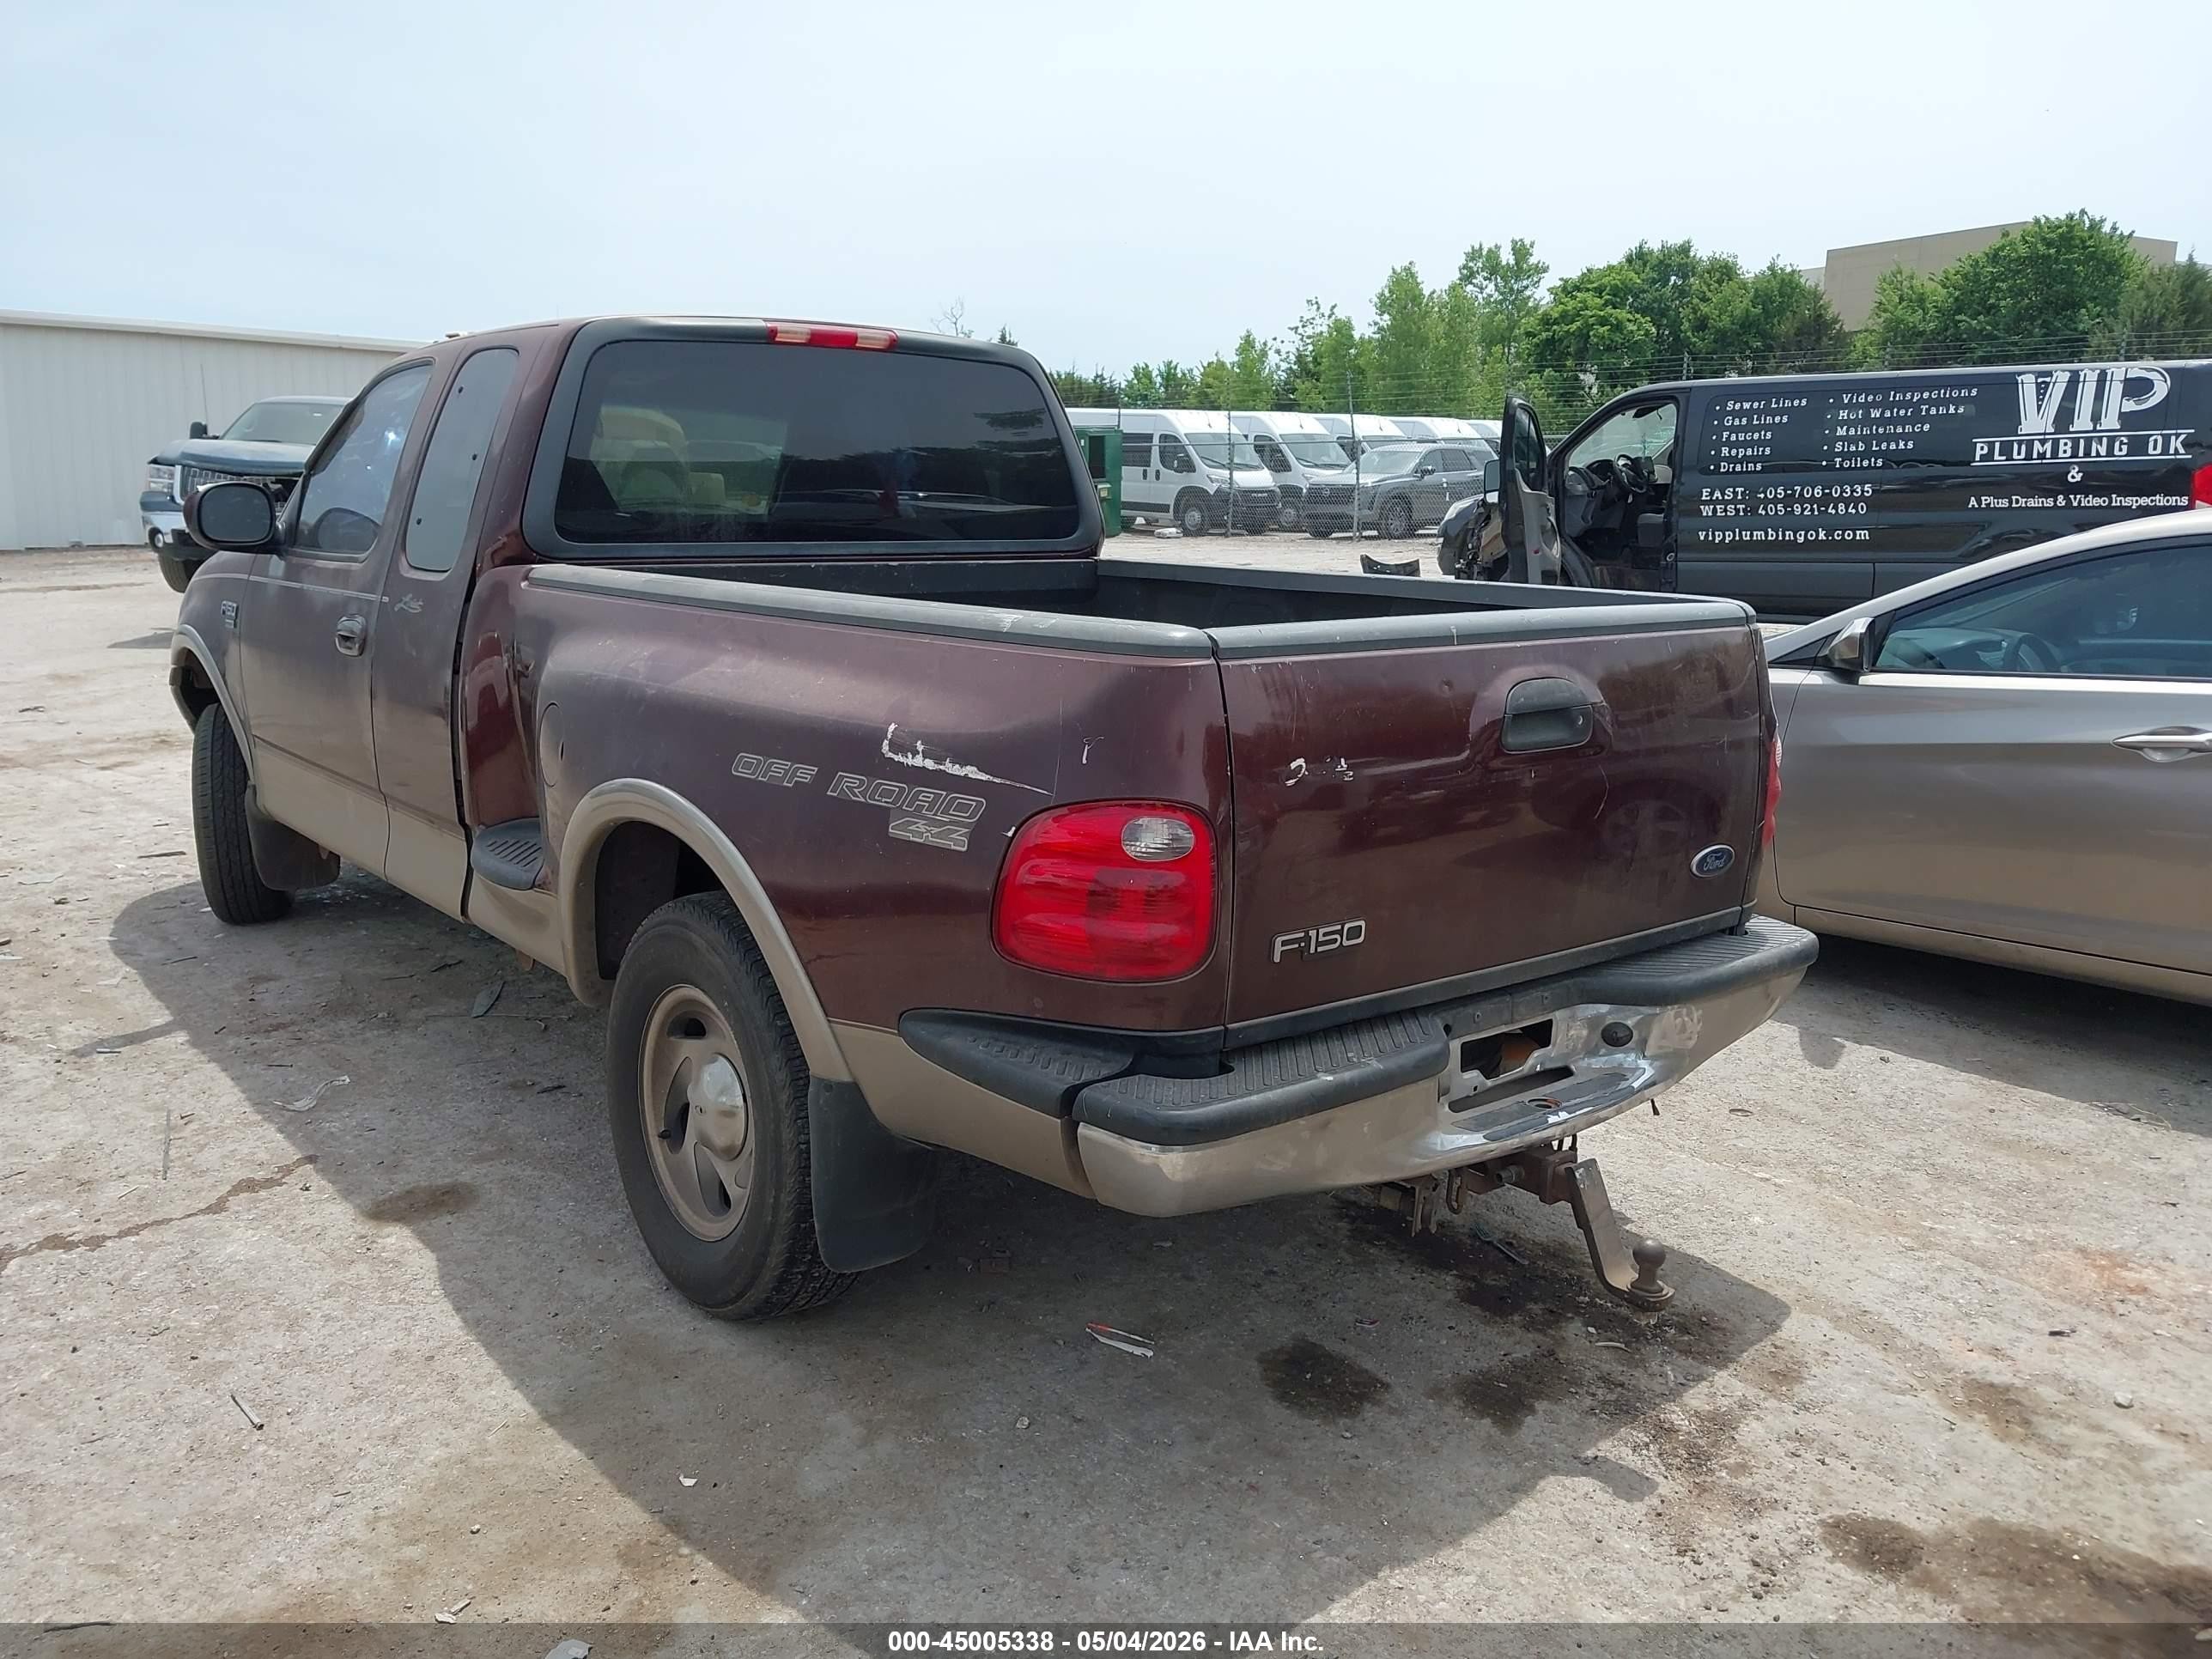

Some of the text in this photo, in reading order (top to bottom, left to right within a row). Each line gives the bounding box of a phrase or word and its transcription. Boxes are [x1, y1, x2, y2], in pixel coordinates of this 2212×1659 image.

[1842, 386, 1978, 404] Video Inspections
[2016, 366, 2172, 434] VIP
[1726, 398, 1808, 410] Sewer Lines
[1838, 404, 1966, 420] Hot Water Tanks
[1723, 414, 1789, 426] Gas Lines
[1721, 430, 1772, 441] Faucets
[1836, 422, 1930, 436] Maintenance
[1720, 446, 1771, 459] Repairs
[1834, 439, 1914, 453] Slab Leaks
[1975, 434, 2189, 462] PLUMBING OK
[1719, 461, 1763, 472] Drains
[1834, 457, 1883, 468] Toilets
[2067, 465, 2084, 483] &
[1701, 483, 1873, 501] EAST: 405-706-0335
[1967, 493, 2189, 508] A Plus Drains & Video Inspections
[1699, 502, 1868, 516] WEST: 405-921-4840
[1698, 527, 1870, 544] vipplumbingok.com
[731, 752, 987, 823] OFF ROAD
